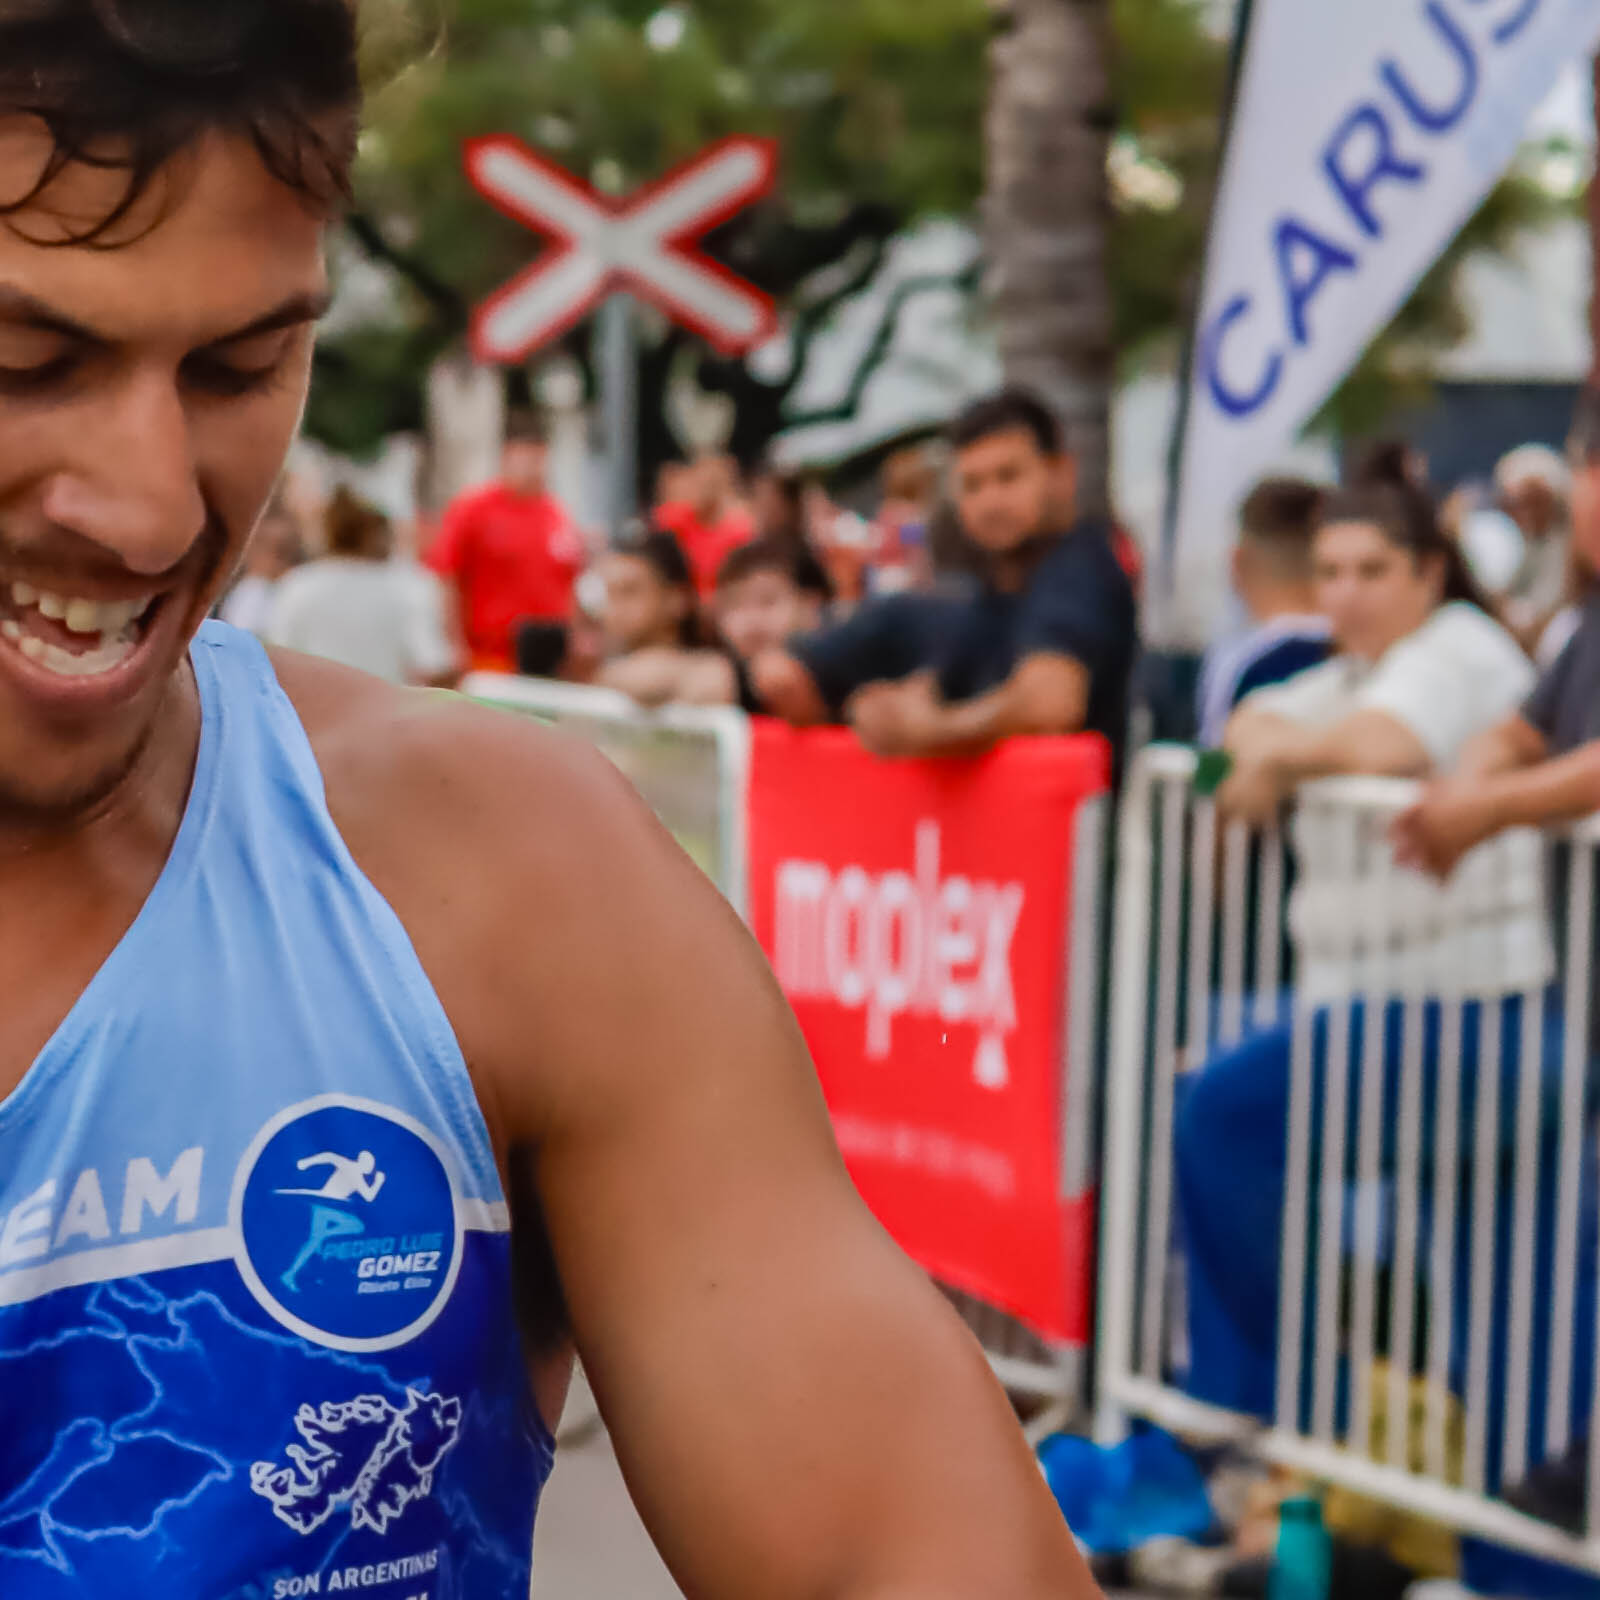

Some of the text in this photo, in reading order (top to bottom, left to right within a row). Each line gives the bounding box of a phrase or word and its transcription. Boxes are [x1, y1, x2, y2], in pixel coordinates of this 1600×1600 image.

[774, 818, 1025, 1065] moplex
[357, 1250, 440, 1278] GOMEZ
[273, 1573, 320, 1600] SON
